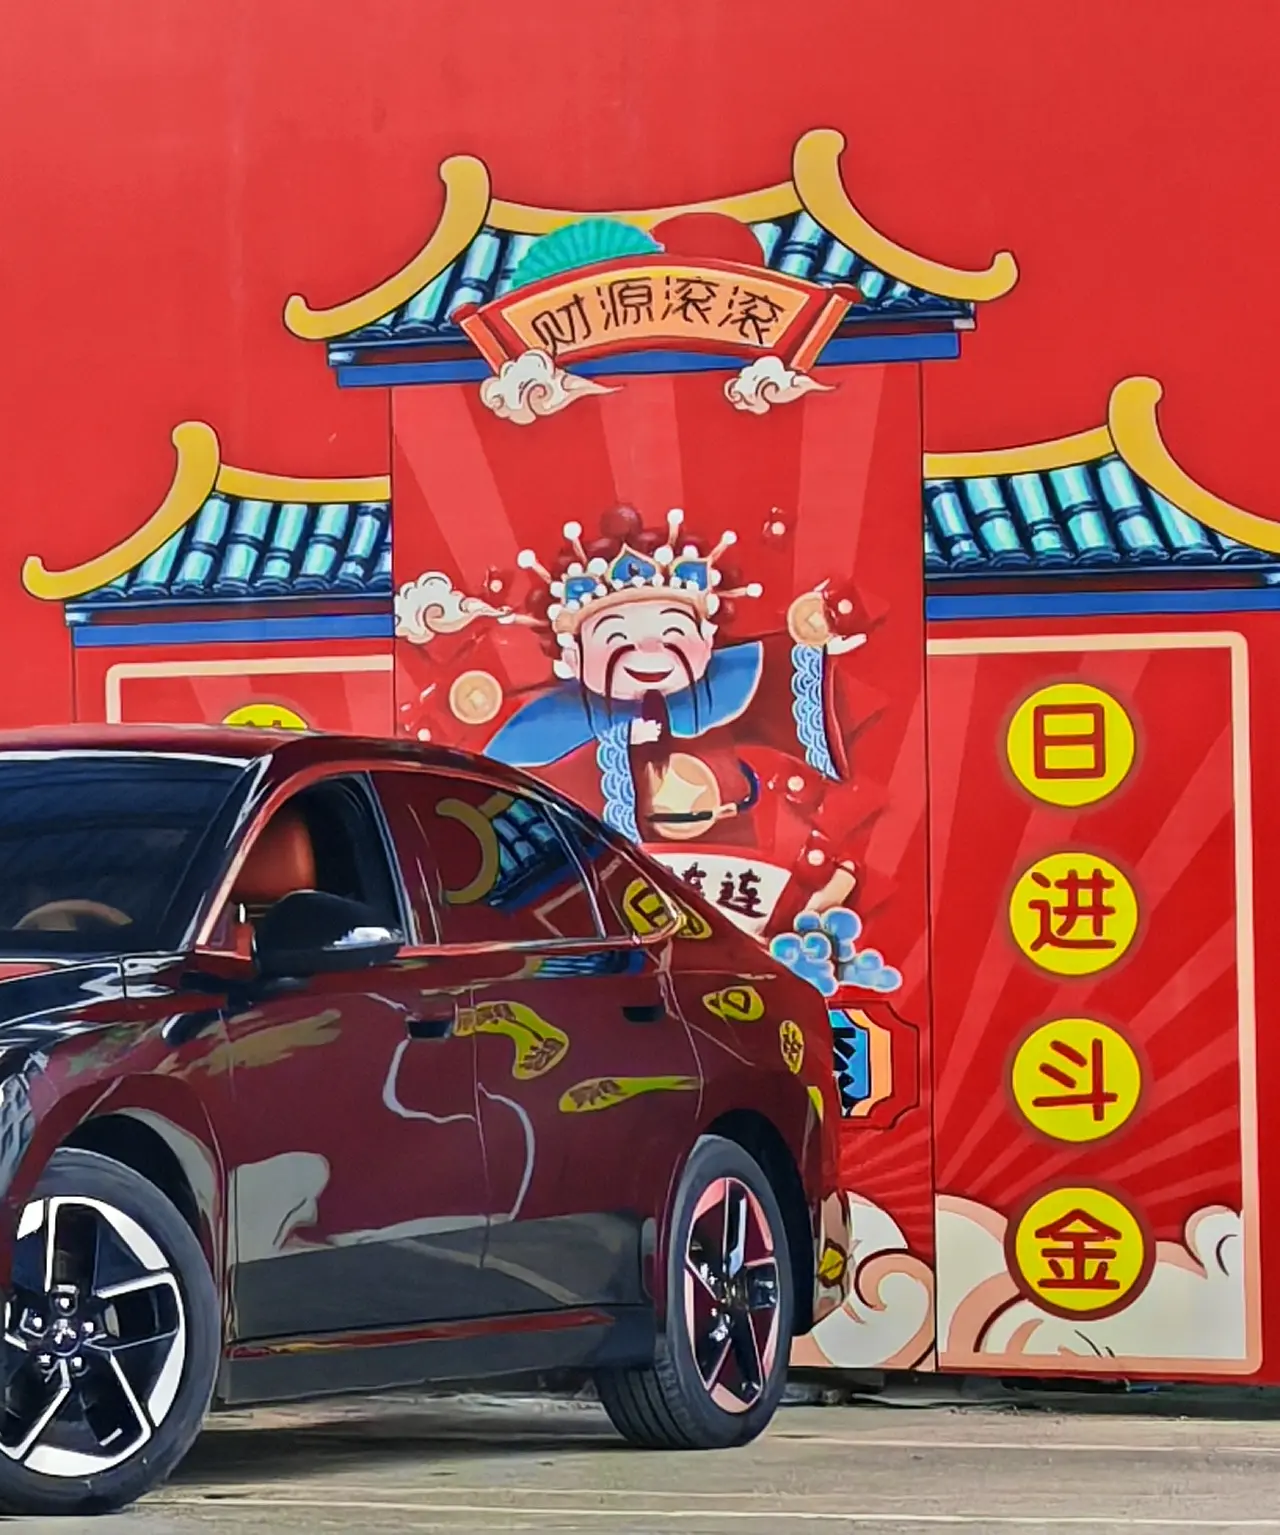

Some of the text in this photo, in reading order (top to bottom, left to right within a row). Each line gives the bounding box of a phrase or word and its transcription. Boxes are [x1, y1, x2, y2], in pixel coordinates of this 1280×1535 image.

[531, 275, 787, 353] 财源滚滚
[1028, 702, 1123, 1290] 日进斗金
